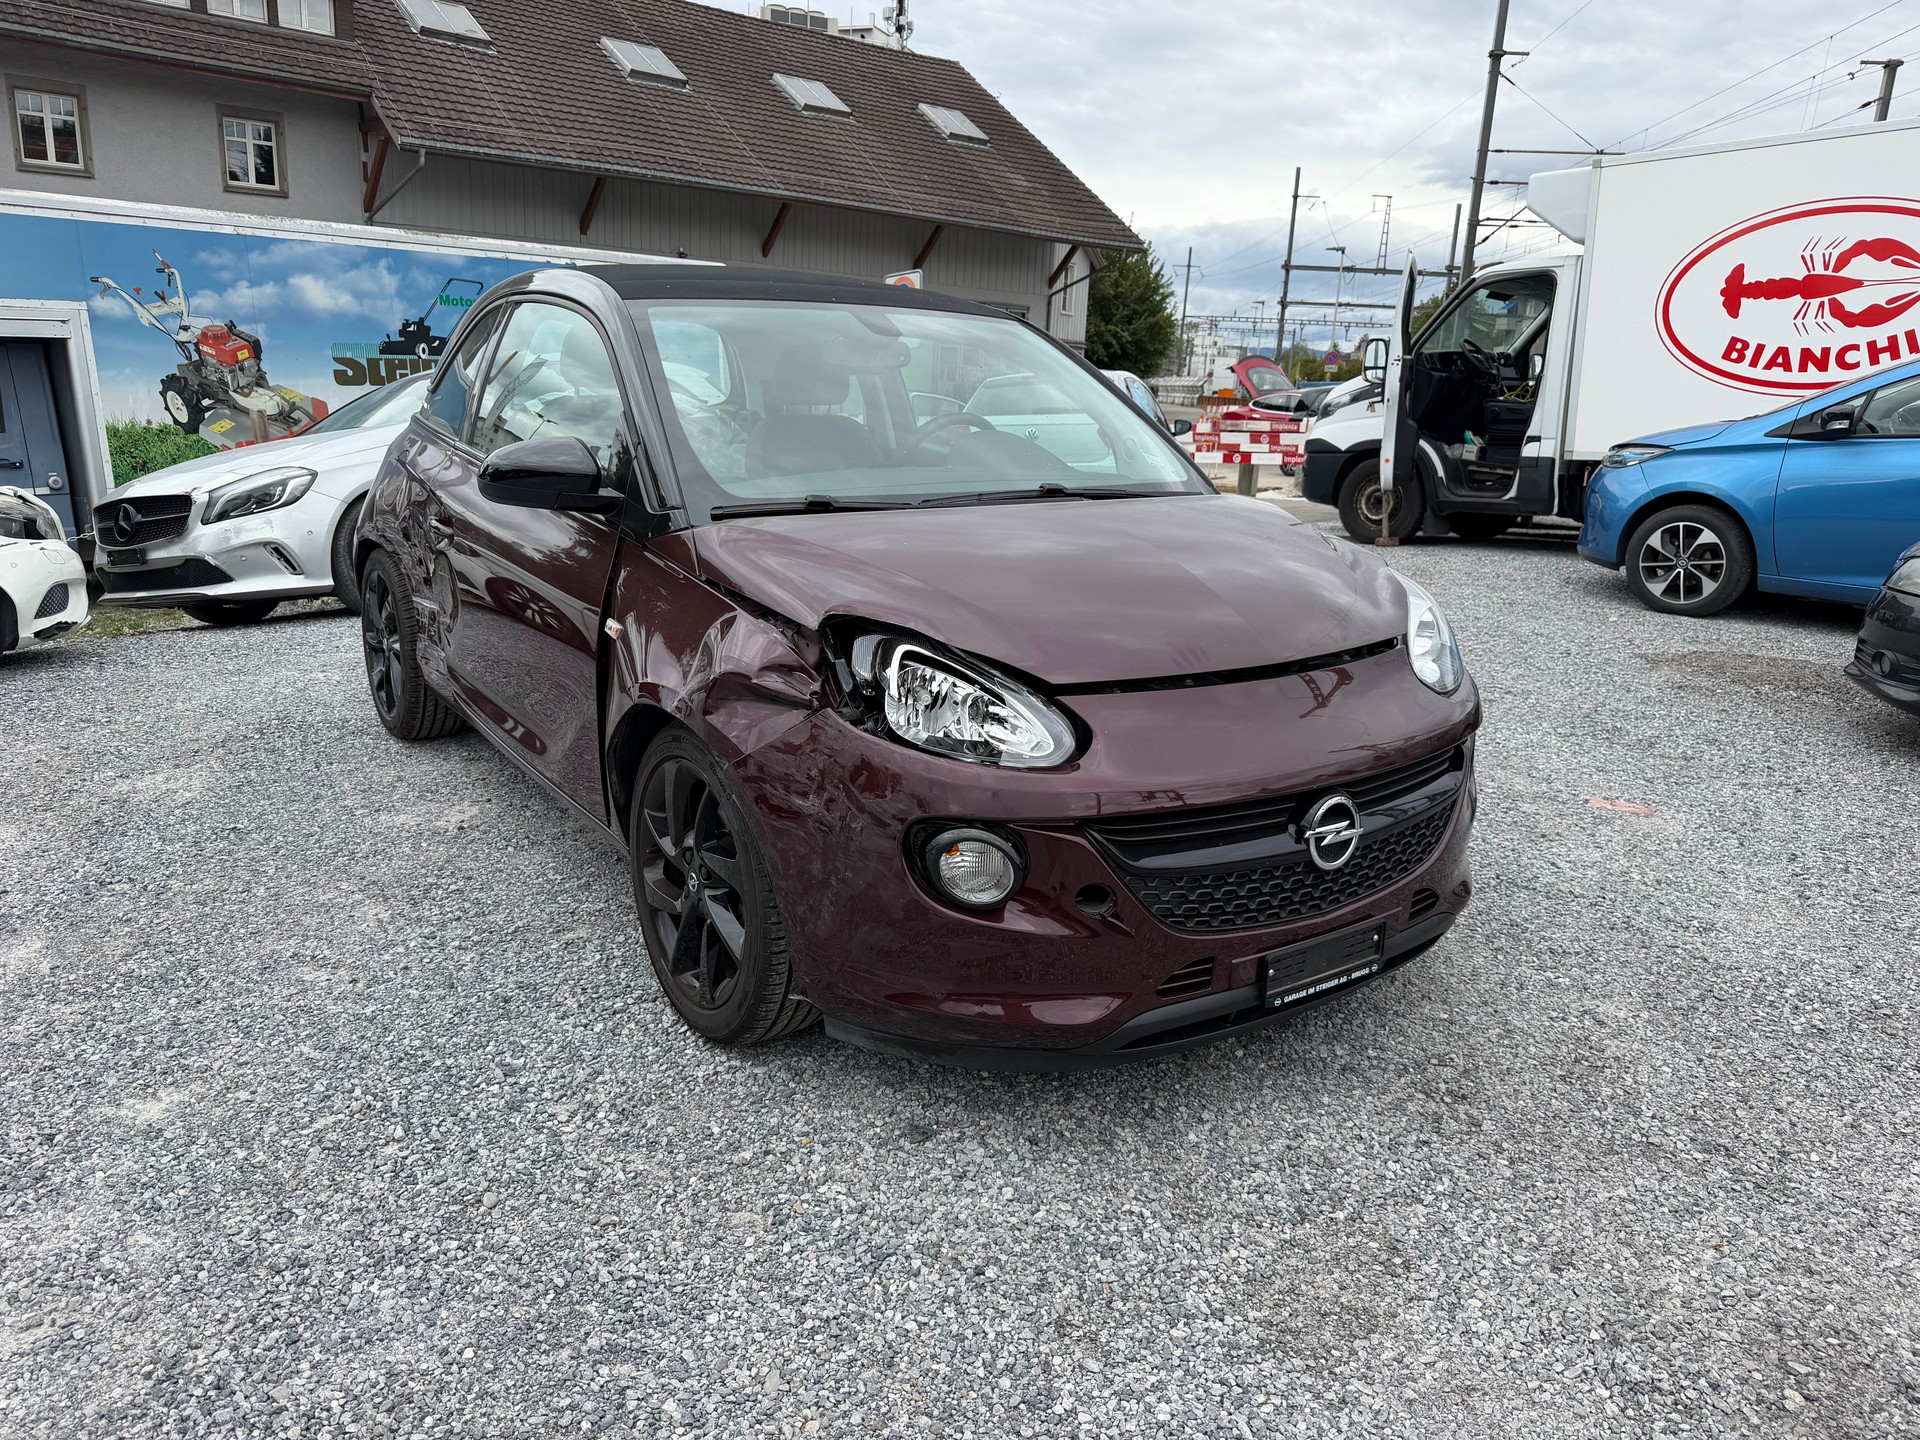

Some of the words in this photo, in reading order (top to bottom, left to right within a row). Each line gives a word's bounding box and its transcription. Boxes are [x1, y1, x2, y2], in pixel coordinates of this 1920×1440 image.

[438, 294, 475, 307] Moto
[1721, 328, 1920, 373] BIANCHI
[1271, 423, 1298, 431] Implenia
[1270, 444, 1296, 453] Implenia
[1284, 990, 1307, 1002] GARAGE
[1315, 979, 1338, 991] STEIGER
[1339, 975, 1347, 984] AG
[1351, 968, 1369, 979] BRUGG
